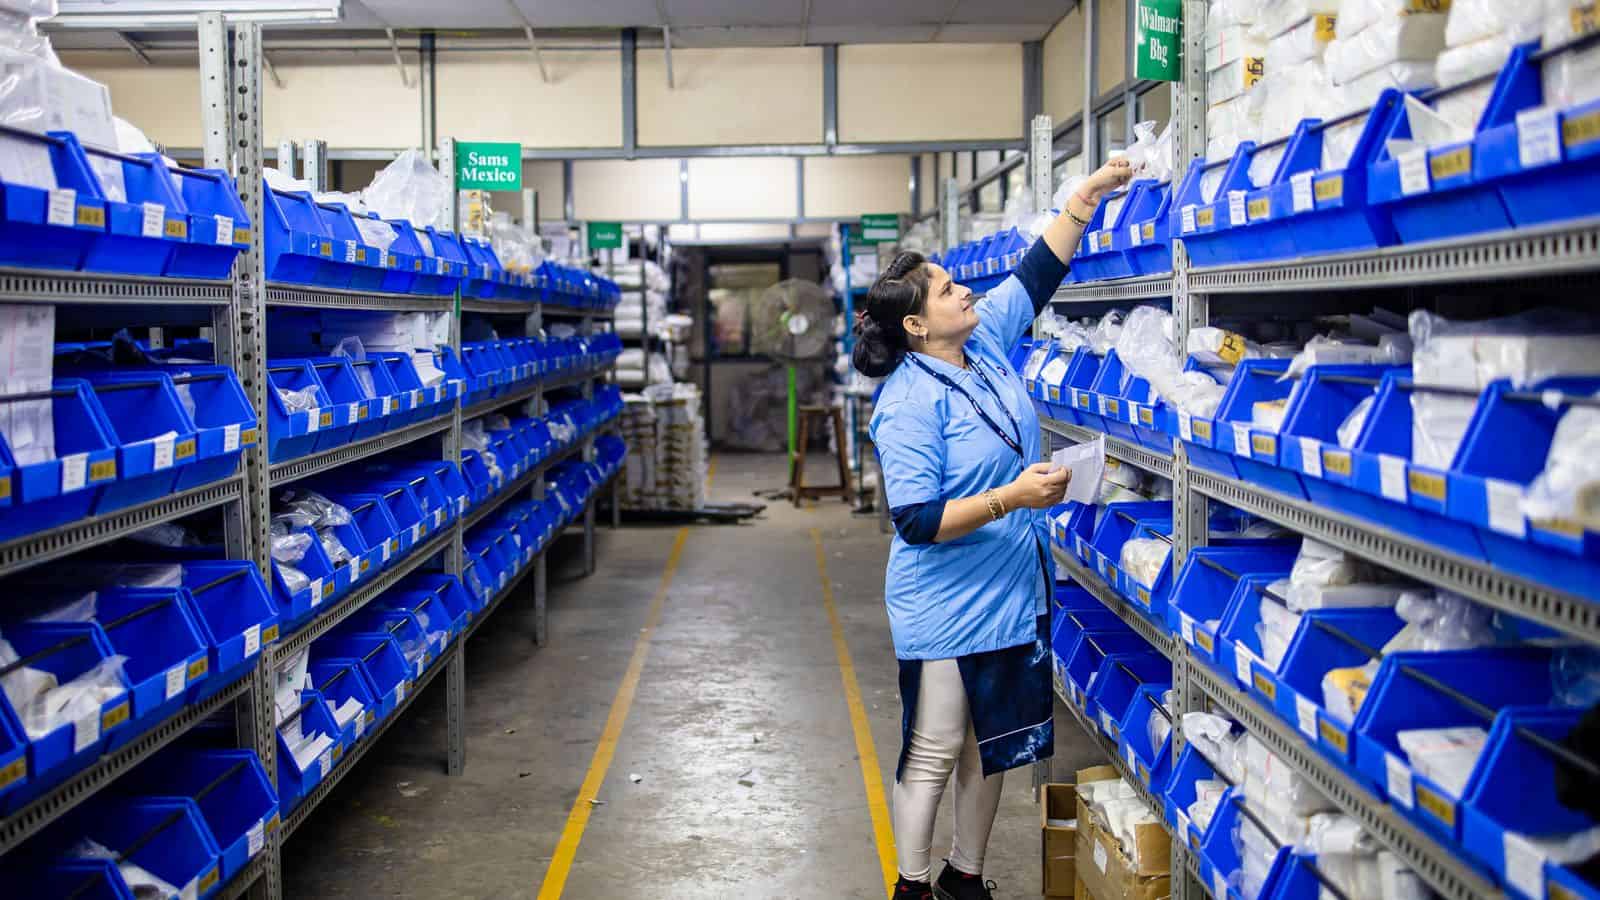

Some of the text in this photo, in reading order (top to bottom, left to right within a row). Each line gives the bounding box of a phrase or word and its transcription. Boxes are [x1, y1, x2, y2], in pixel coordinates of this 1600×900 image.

[1140, 5, 1179, 34] Walmart
[1150, 37, 1168, 68] Bhg
[468, 151, 509, 167] Sams
[462, 167, 517, 182] Mexico
